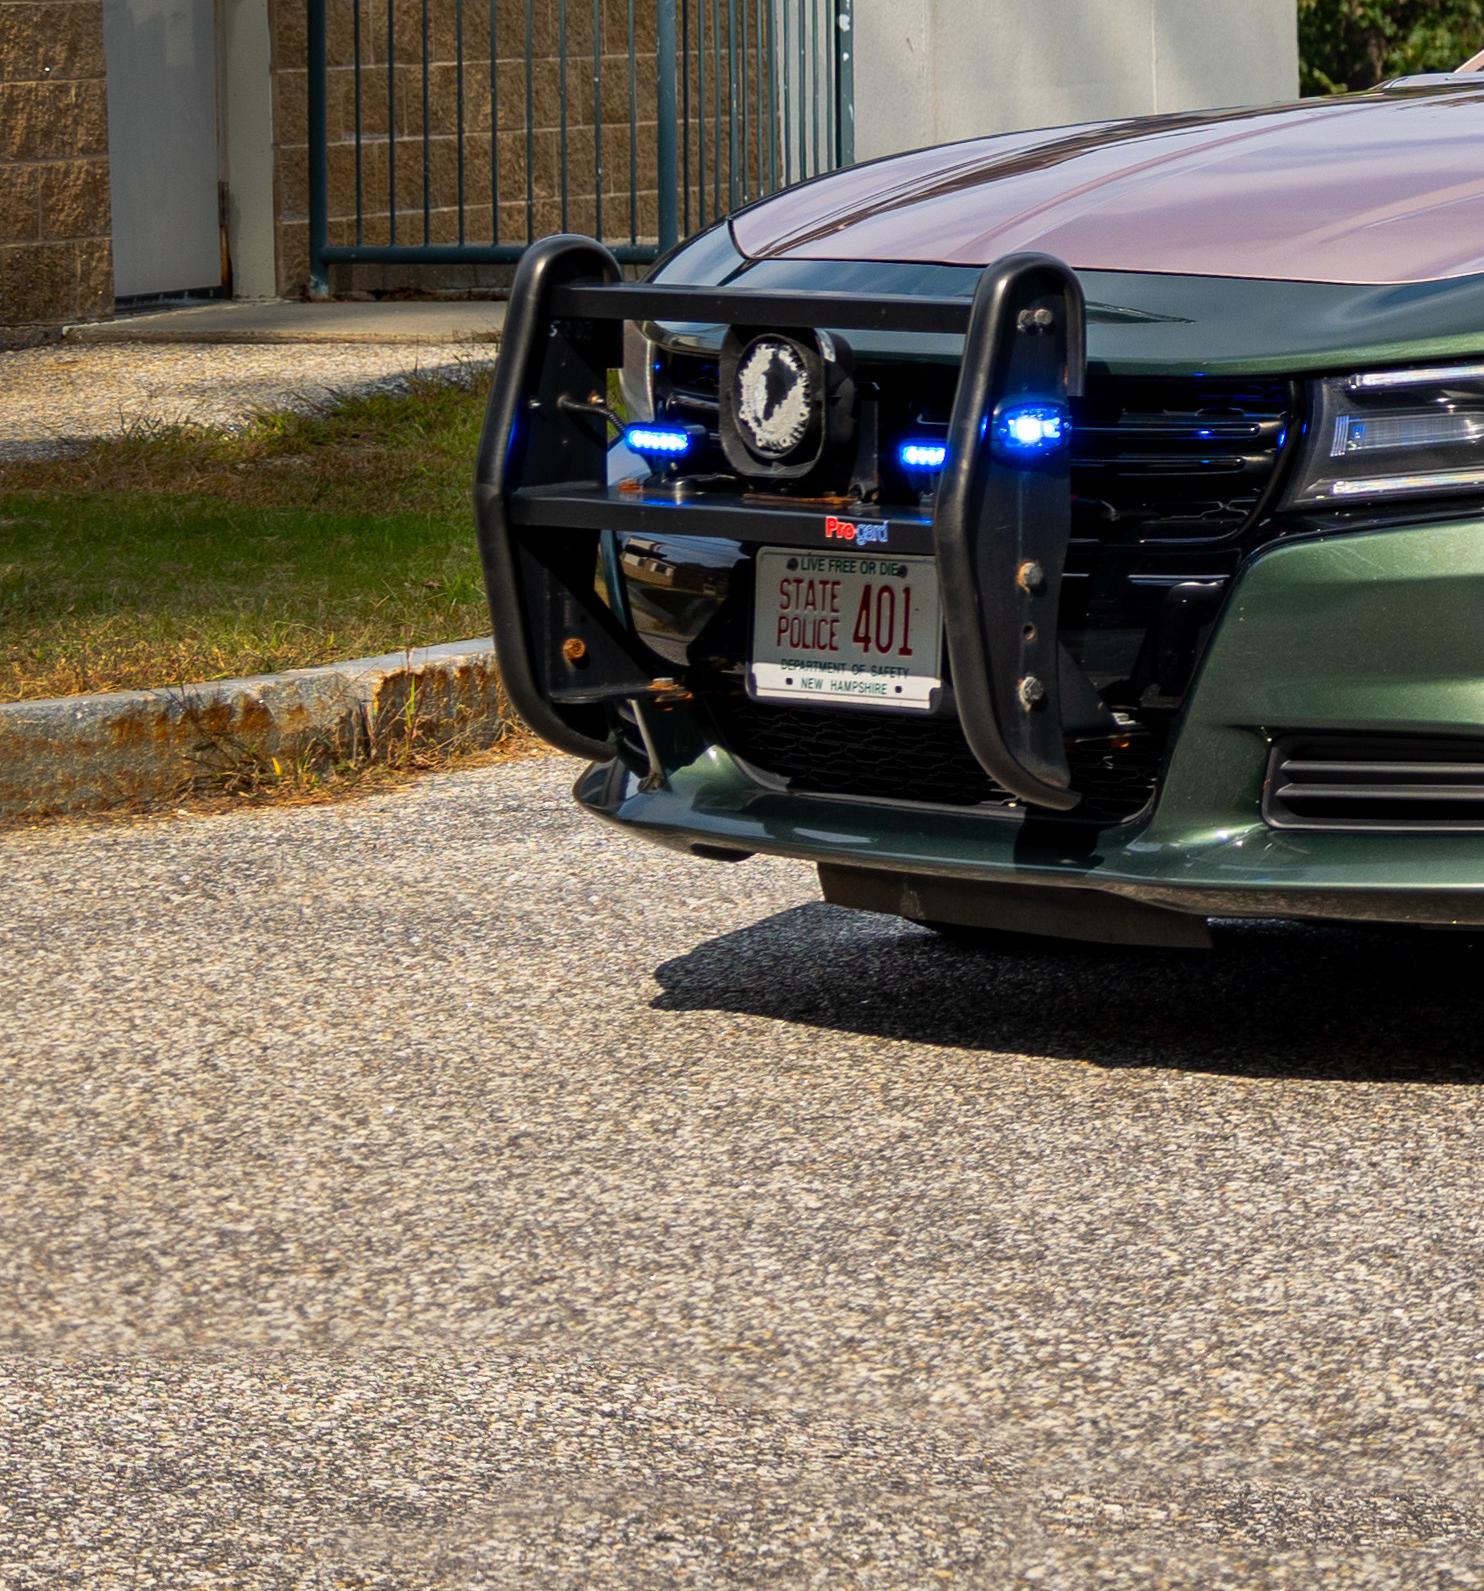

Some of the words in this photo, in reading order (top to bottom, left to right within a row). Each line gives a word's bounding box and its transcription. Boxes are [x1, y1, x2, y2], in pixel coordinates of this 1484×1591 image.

[800, 558, 825, 572] LIVE
[828, 559, 856, 574] FREE
[859, 561, 877, 575] OR
[879, 562, 899, 577] DIE
[779, 578, 841, 614] STATE
[776, 615, 841, 652] POLICE
[852, 584, 913, 657] 401
[780, 659, 847, 674] DEPARTMENT
[851, 663, 867, 676] OF
[870, 665, 910, 680] SAFETY
[800, 677, 824, 691] NEW
[830, 679, 888, 695] HAMPSHIRE
